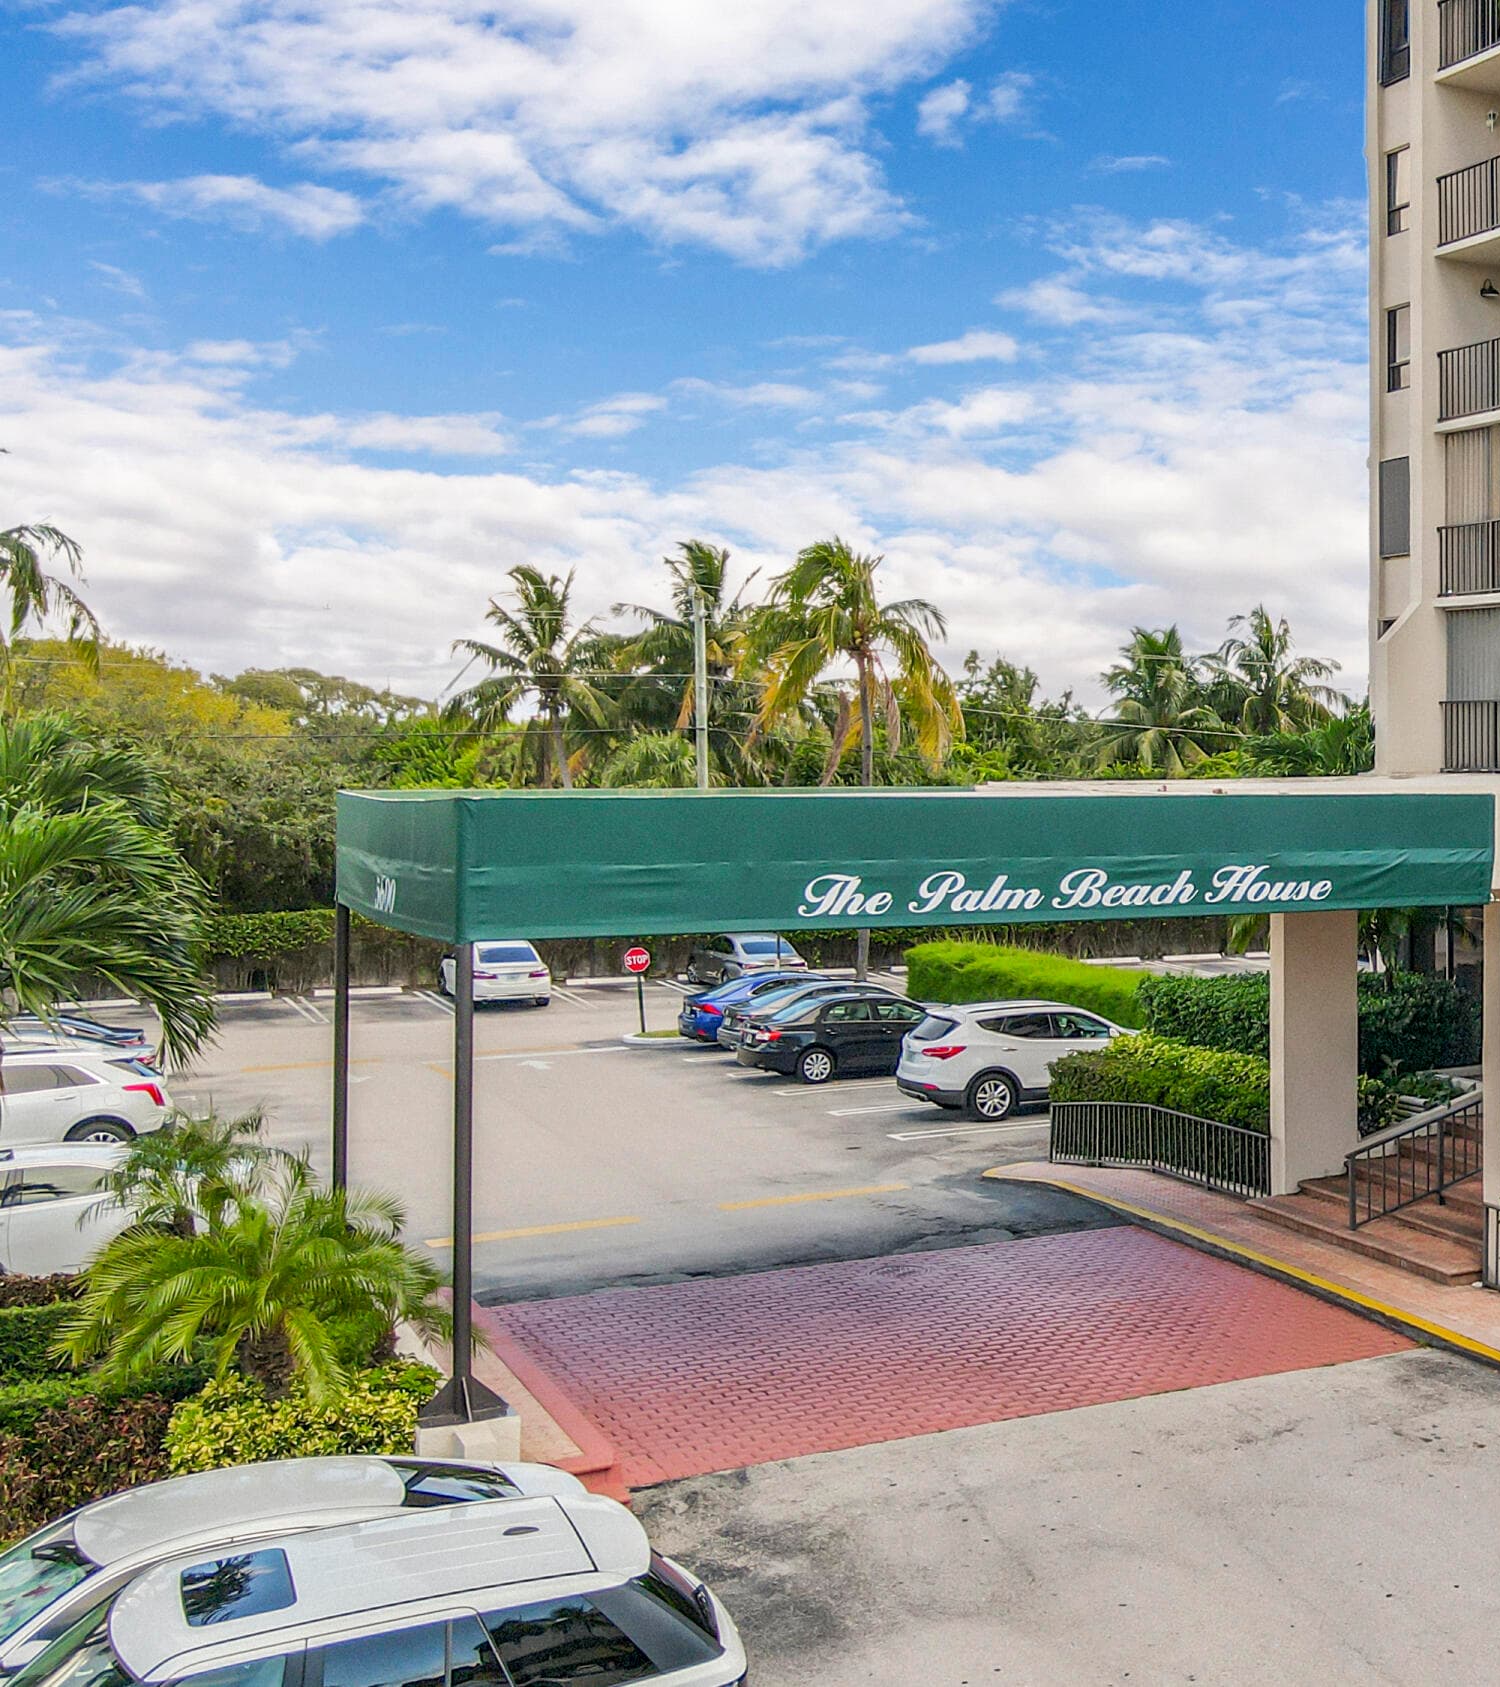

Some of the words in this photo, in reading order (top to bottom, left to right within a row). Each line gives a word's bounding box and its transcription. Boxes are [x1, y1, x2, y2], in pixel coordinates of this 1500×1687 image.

[797, 873, 893, 917] The
[908, 871, 1045, 914] Palm
[1051, 868, 1198, 910] Beach
[1204, 864, 1333, 904] House
[626, 954, 648, 966] STOP
